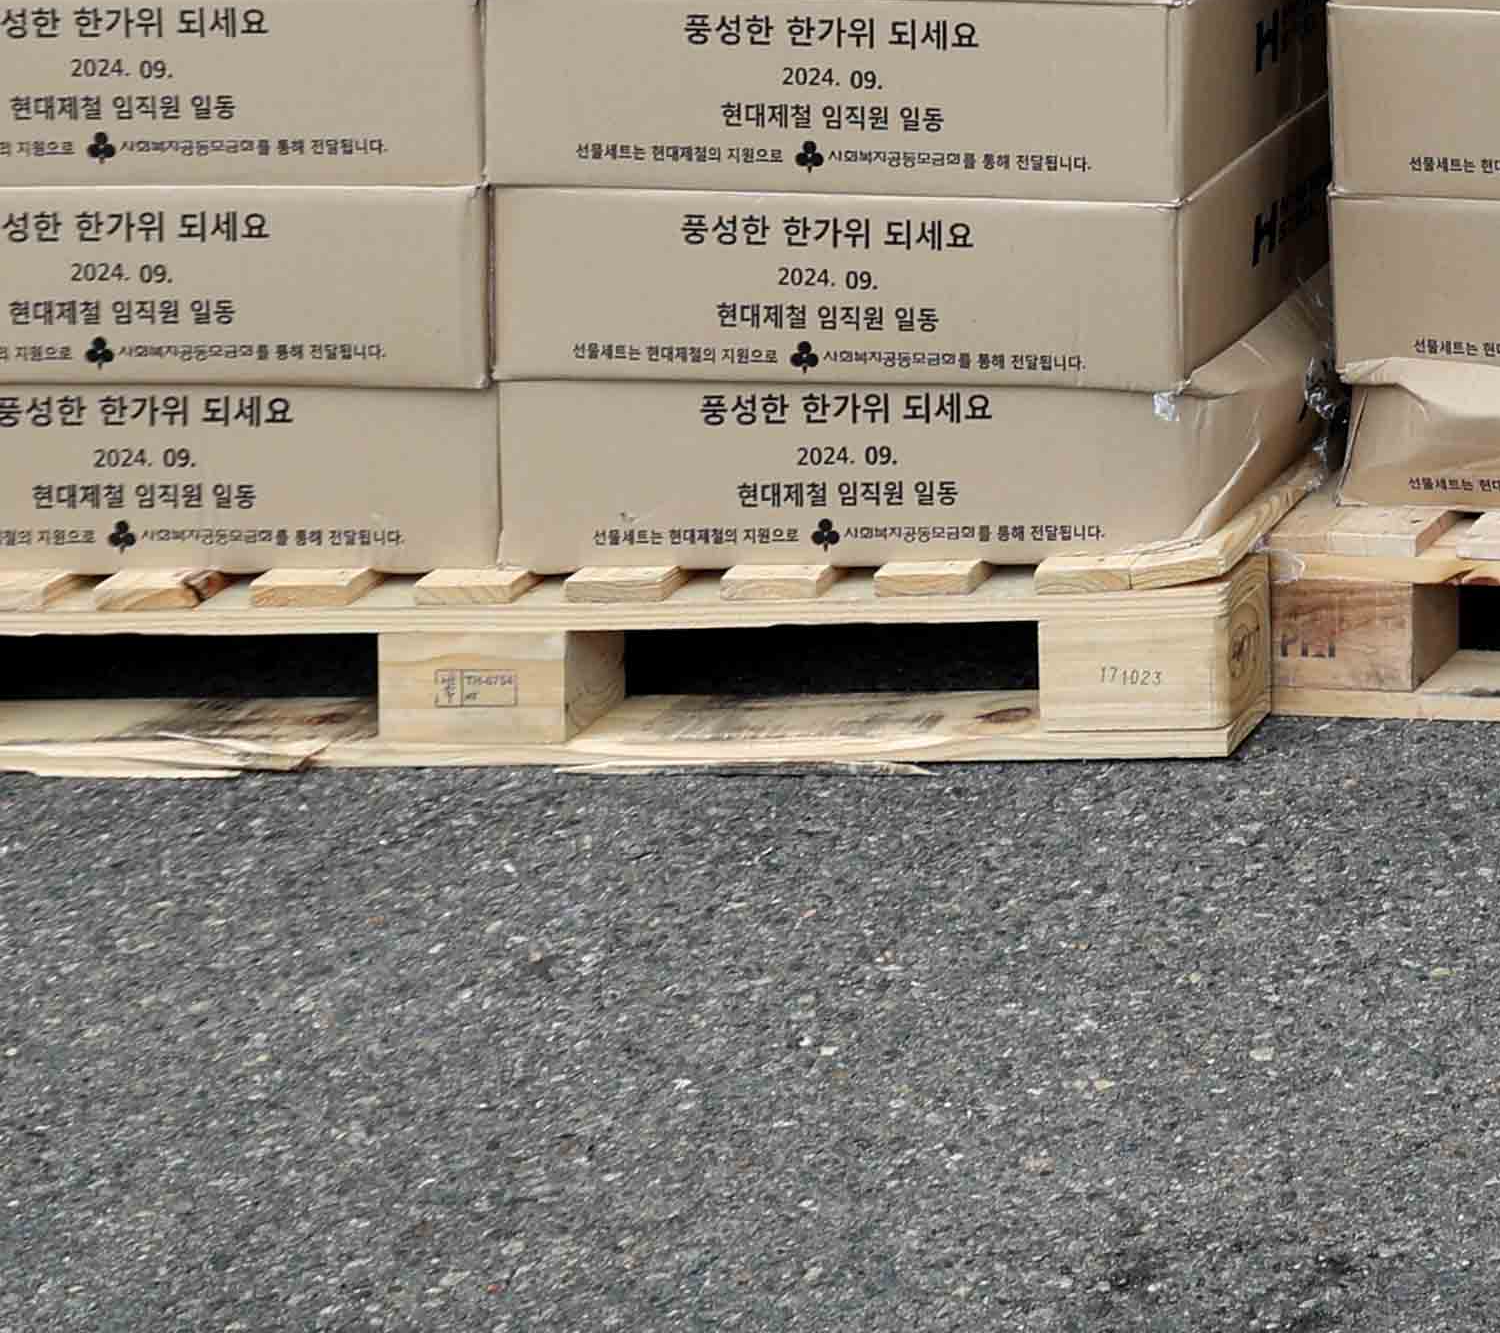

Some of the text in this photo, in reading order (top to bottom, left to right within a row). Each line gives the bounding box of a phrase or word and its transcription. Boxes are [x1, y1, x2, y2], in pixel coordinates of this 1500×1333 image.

[699, 392, 998, 427] 풍성한 한가위 되세요
[796, 445, 899, 467] 2024. 09.
[736, 479, 959, 509] 현대제철 임직원 일동
[592, 528, 665, 547] 선물세트는
[668, 527, 738, 546] 현대제철의
[742, 527, 800, 545] 지원으로
[996, 524, 1025, 542] 통해
[1029, 524, 1105, 542] 전달됩니다.
